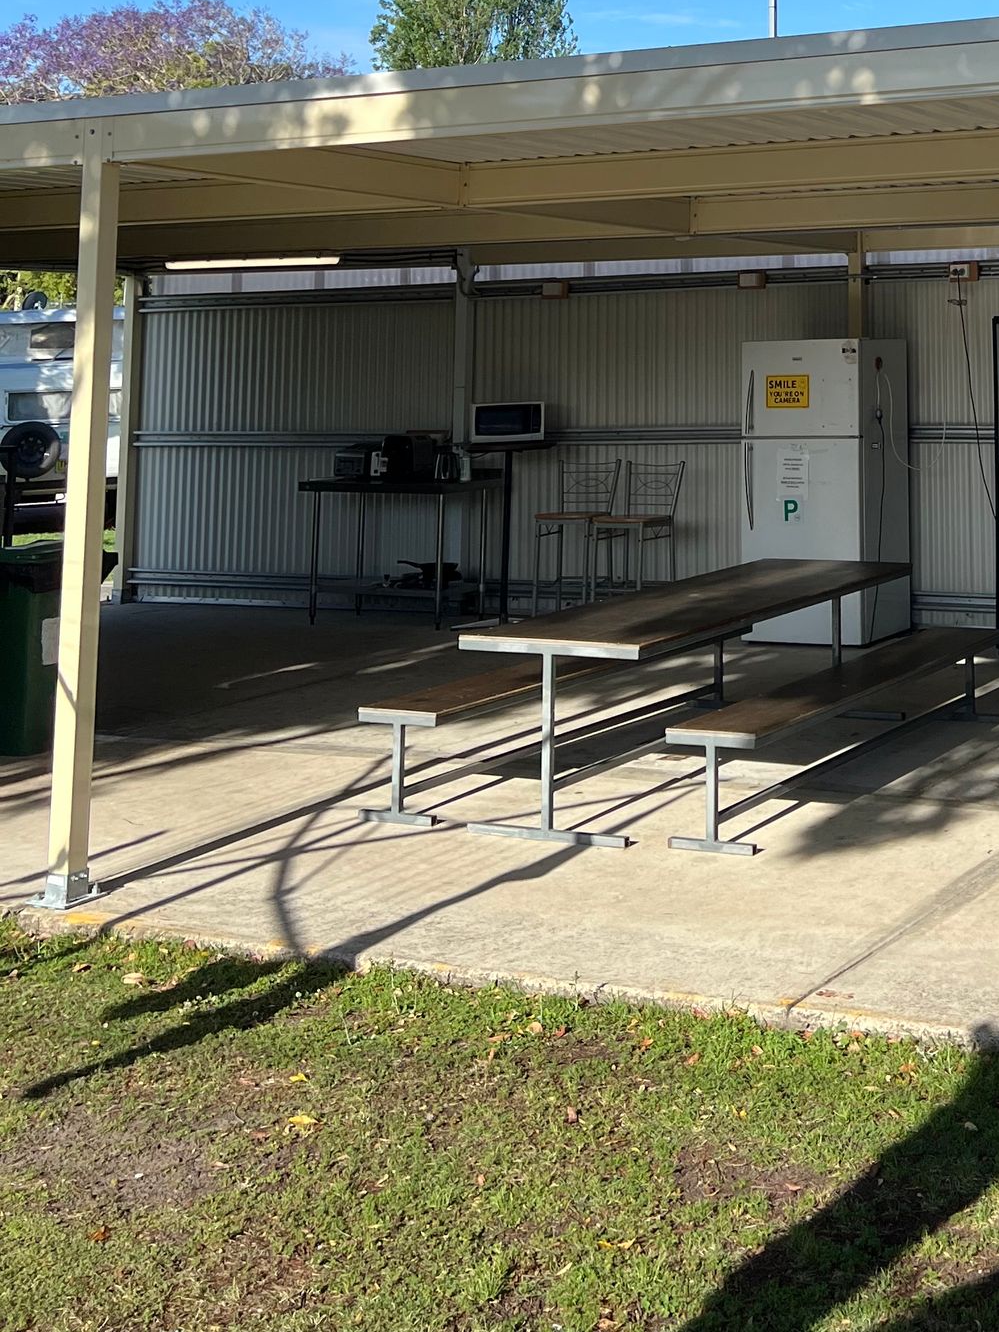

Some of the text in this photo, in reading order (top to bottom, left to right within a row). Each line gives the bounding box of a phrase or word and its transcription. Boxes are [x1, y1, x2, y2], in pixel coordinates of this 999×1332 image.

[769, 380, 797, 389] SMILE
[794, 390, 804, 398] ON
[784, 499, 798, 521] P
